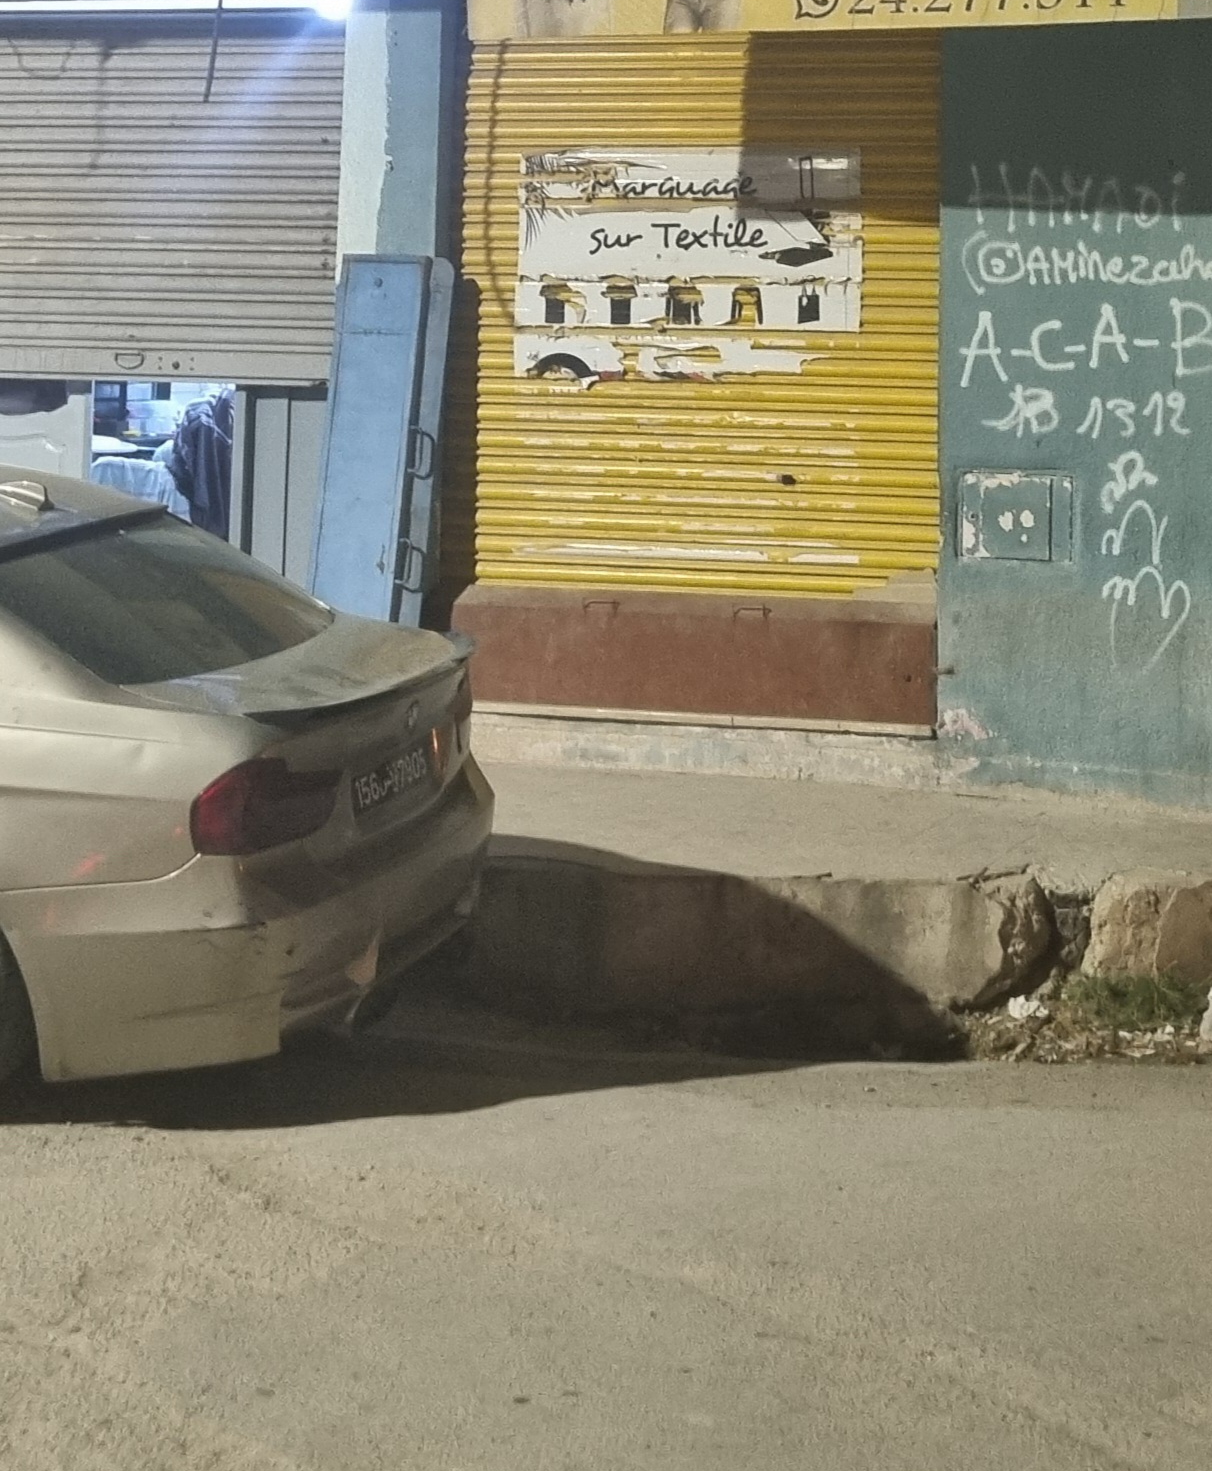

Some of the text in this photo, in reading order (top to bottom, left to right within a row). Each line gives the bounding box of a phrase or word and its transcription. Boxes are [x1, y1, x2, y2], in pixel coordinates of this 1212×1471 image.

[589, 214, 768, 255] sur Textile
[1076, 391, 1193, 439] 1312
